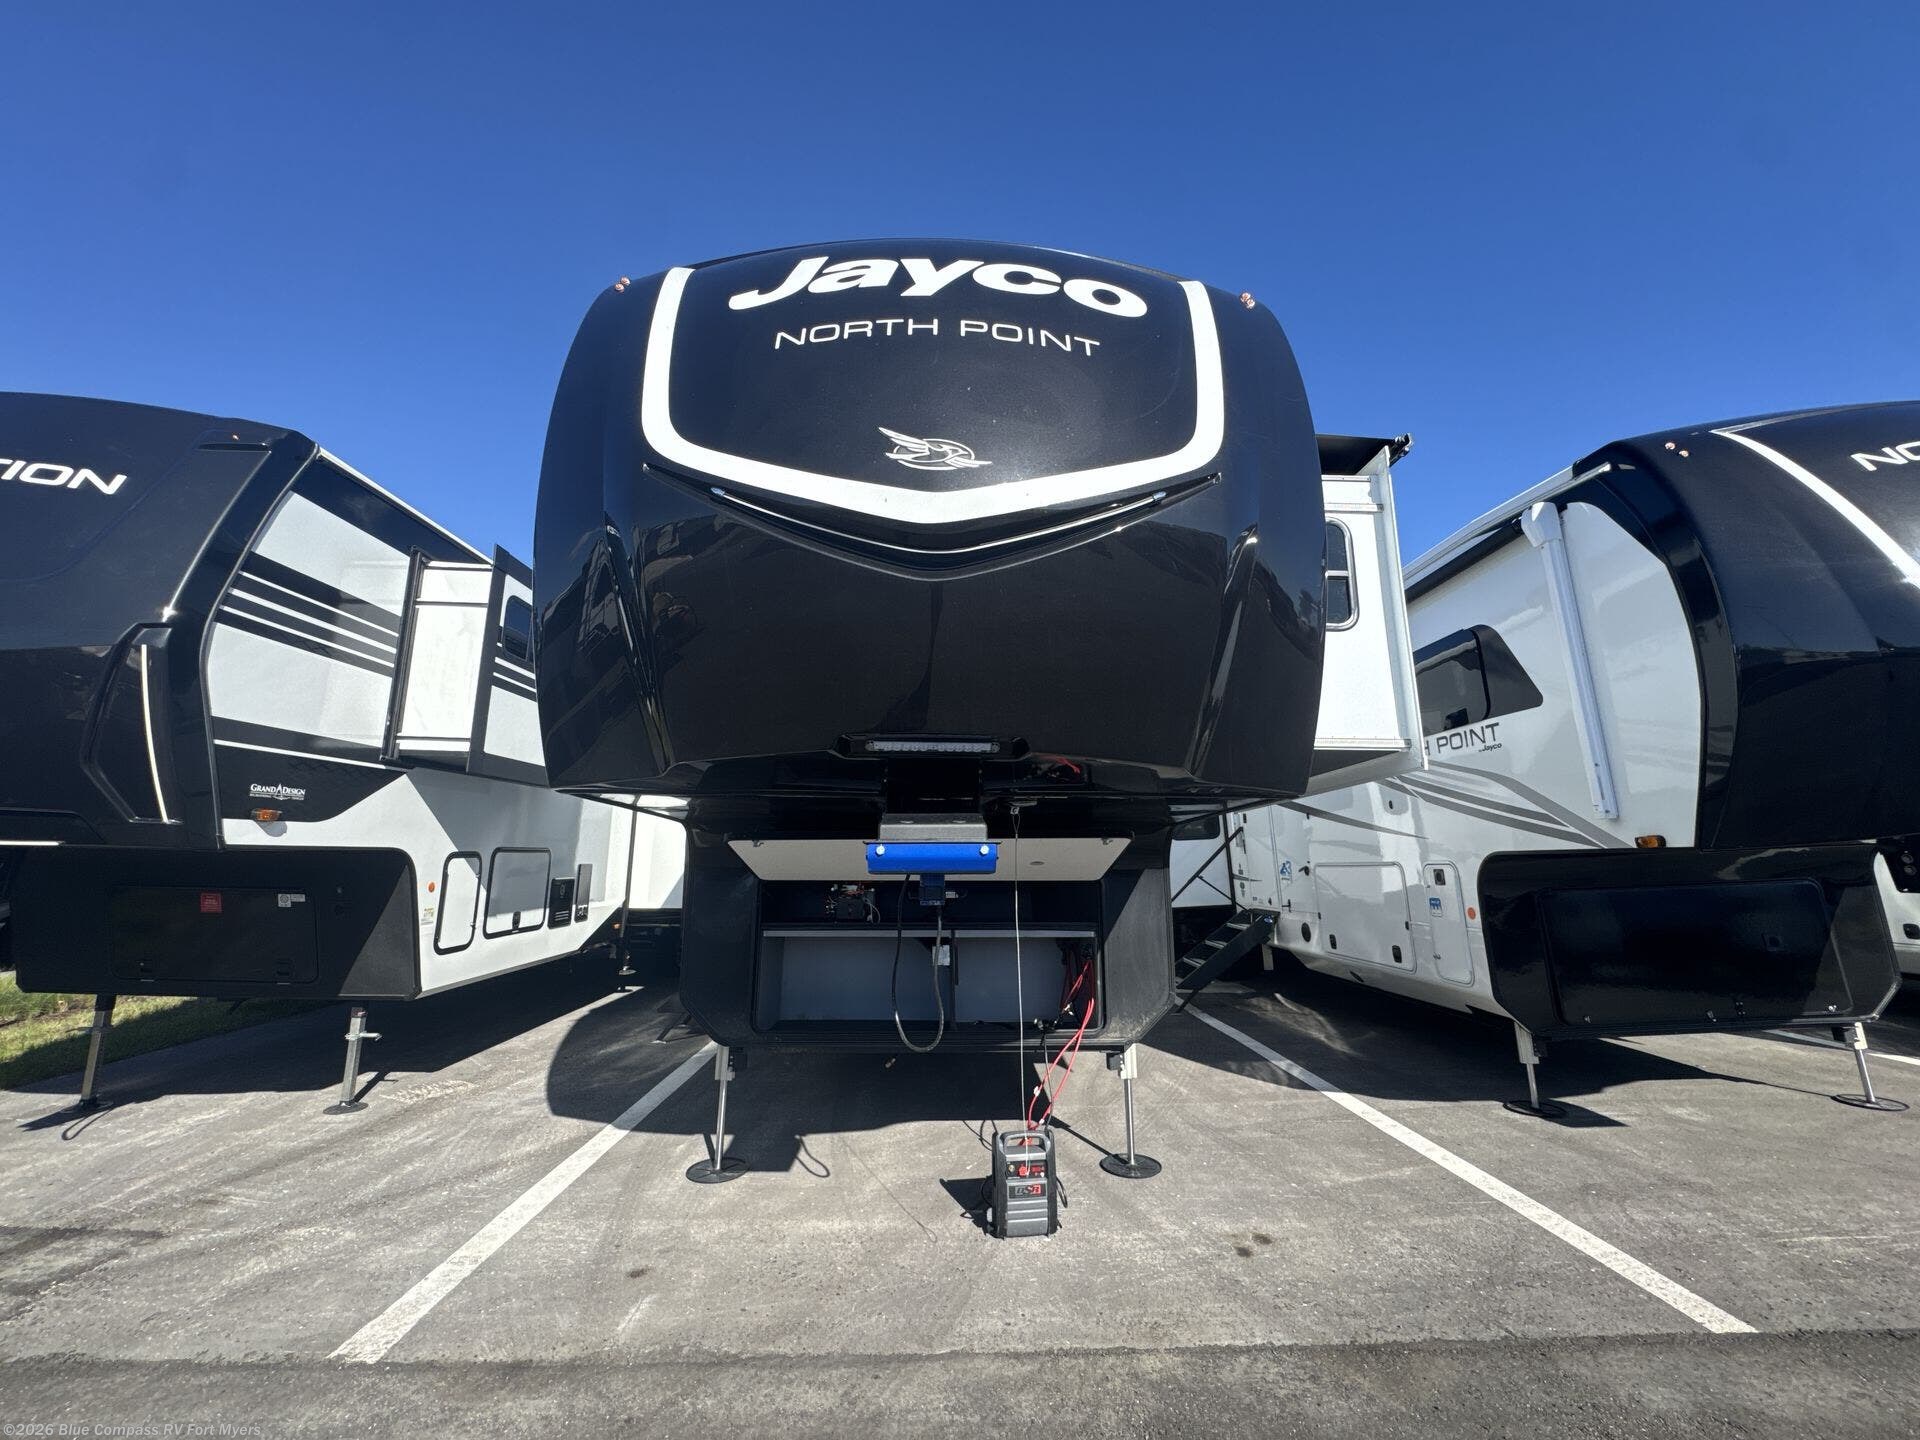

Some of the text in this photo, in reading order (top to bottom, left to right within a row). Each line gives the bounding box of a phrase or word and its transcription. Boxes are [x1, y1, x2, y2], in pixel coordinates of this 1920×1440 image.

[729, 256, 1147, 317] Jayco
[775, 318, 1101, 357] NORTH POINT
[1436, 722, 1500, 754] POINT
